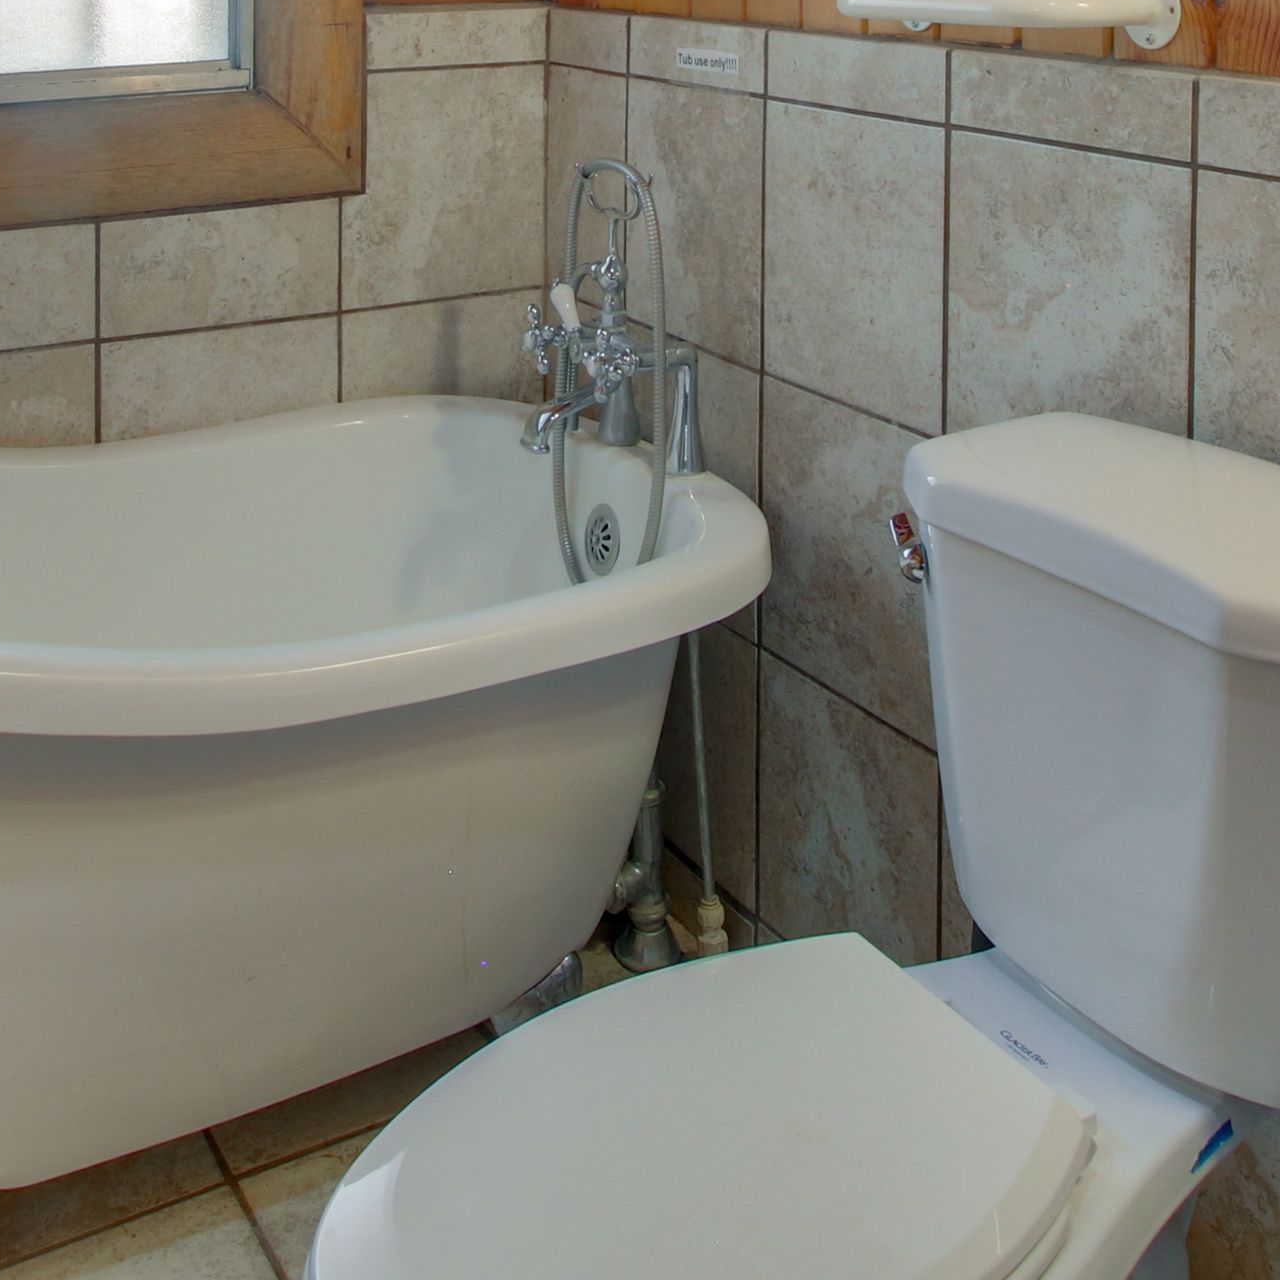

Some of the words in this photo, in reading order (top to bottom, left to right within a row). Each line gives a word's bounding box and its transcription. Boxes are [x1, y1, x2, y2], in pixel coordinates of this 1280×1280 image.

[678, 53, 692, 65] Tub
[694, 57, 709, 67] use
[1000, 1030, 1033, 1056] GLACIER
